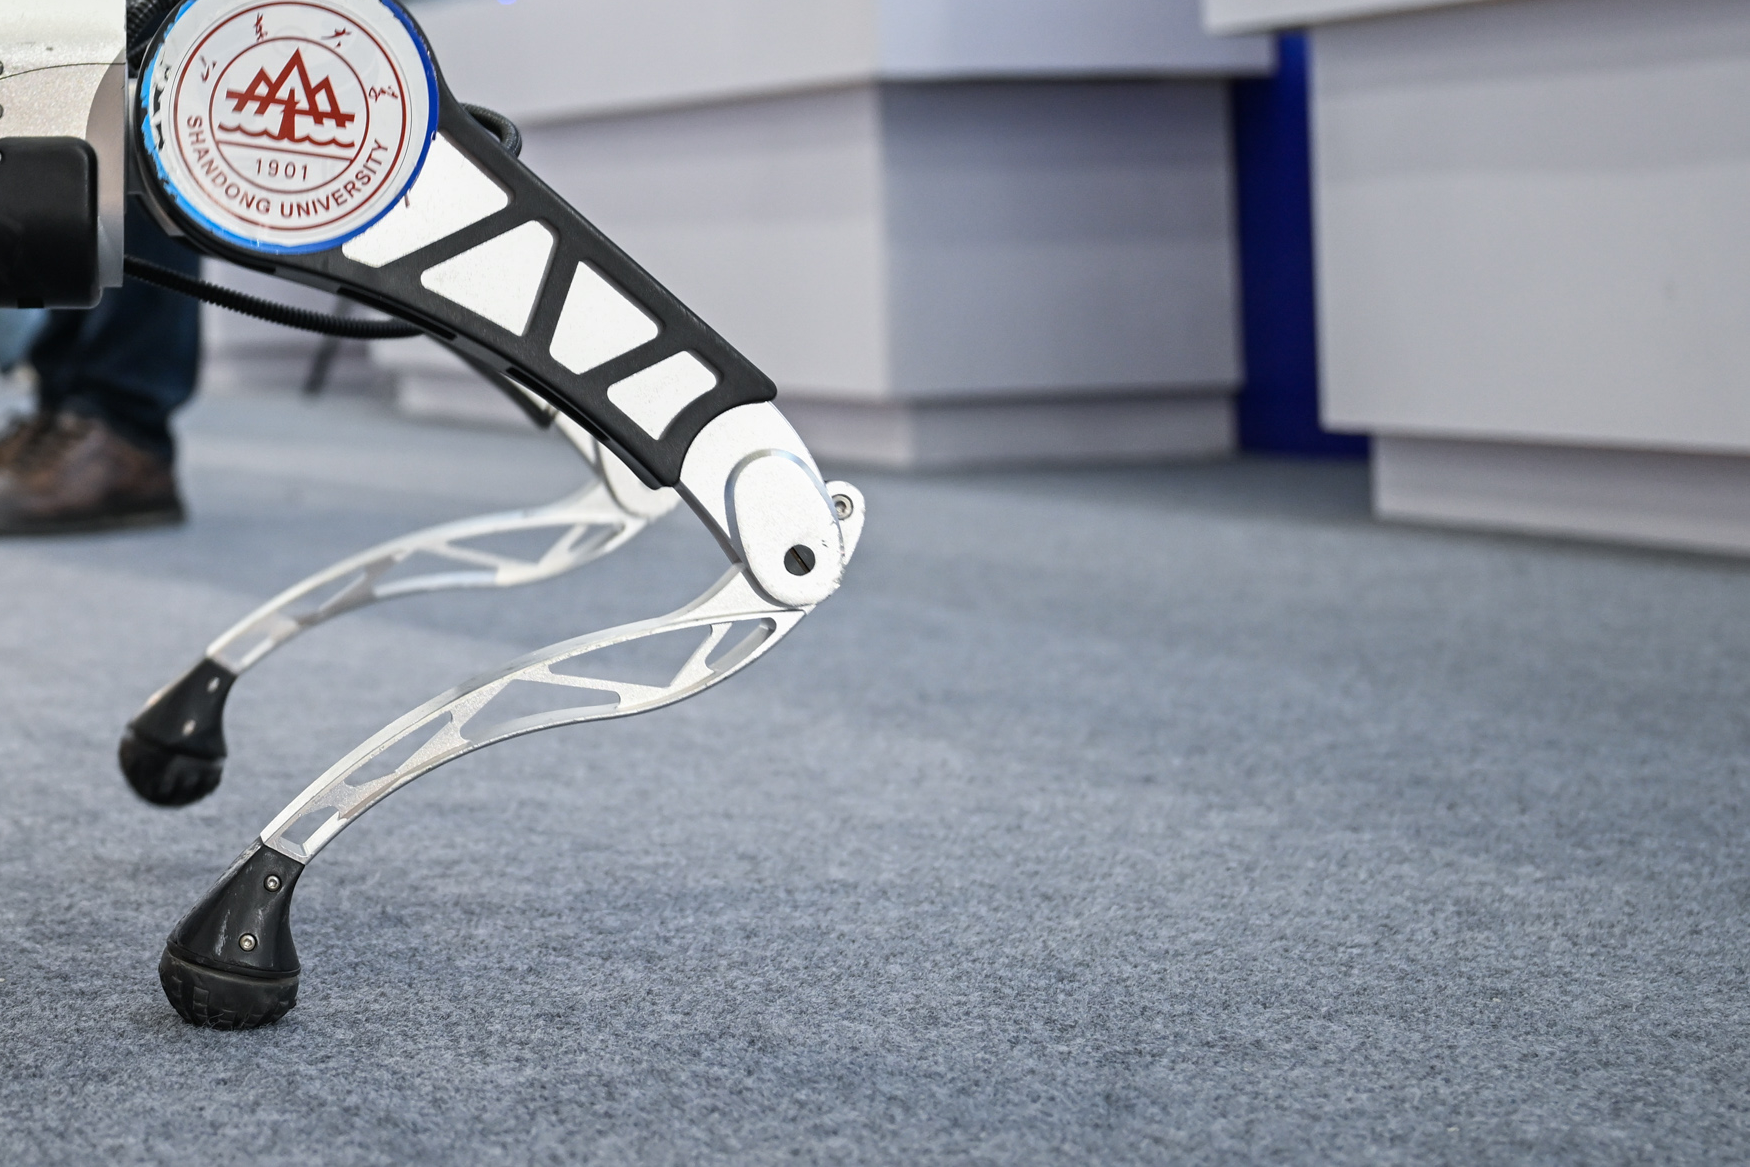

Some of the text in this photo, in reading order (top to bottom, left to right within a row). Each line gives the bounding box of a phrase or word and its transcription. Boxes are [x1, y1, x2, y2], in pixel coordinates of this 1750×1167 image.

[186, 114, 389, 218] SHANDONG UNIVERSITY
[255, 157, 309, 182] 1901
